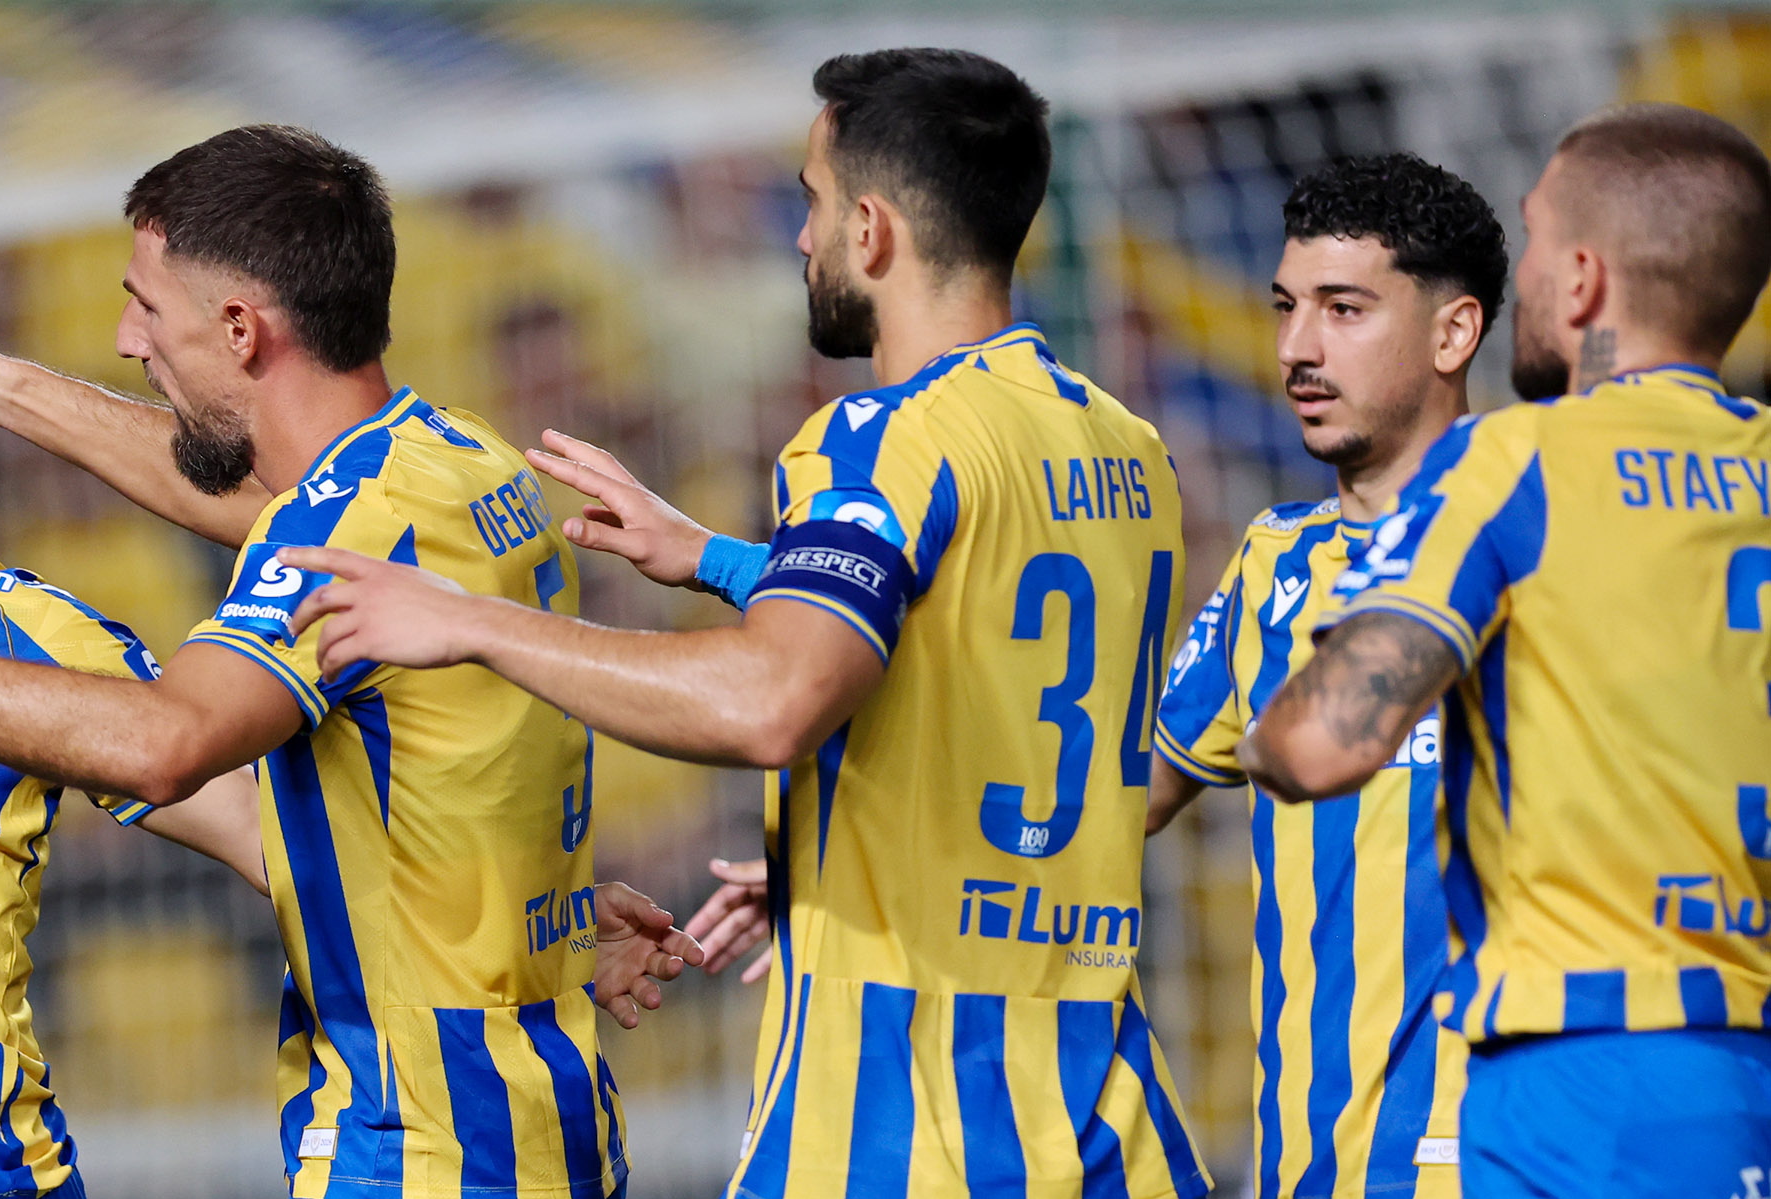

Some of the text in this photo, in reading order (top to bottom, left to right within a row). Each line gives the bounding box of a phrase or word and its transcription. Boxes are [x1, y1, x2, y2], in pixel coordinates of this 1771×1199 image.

[1041, 457, 1153, 522] LAIFIS
[780, 551, 886, 589] RESPECT
[978, 550, 1174, 859] 34
